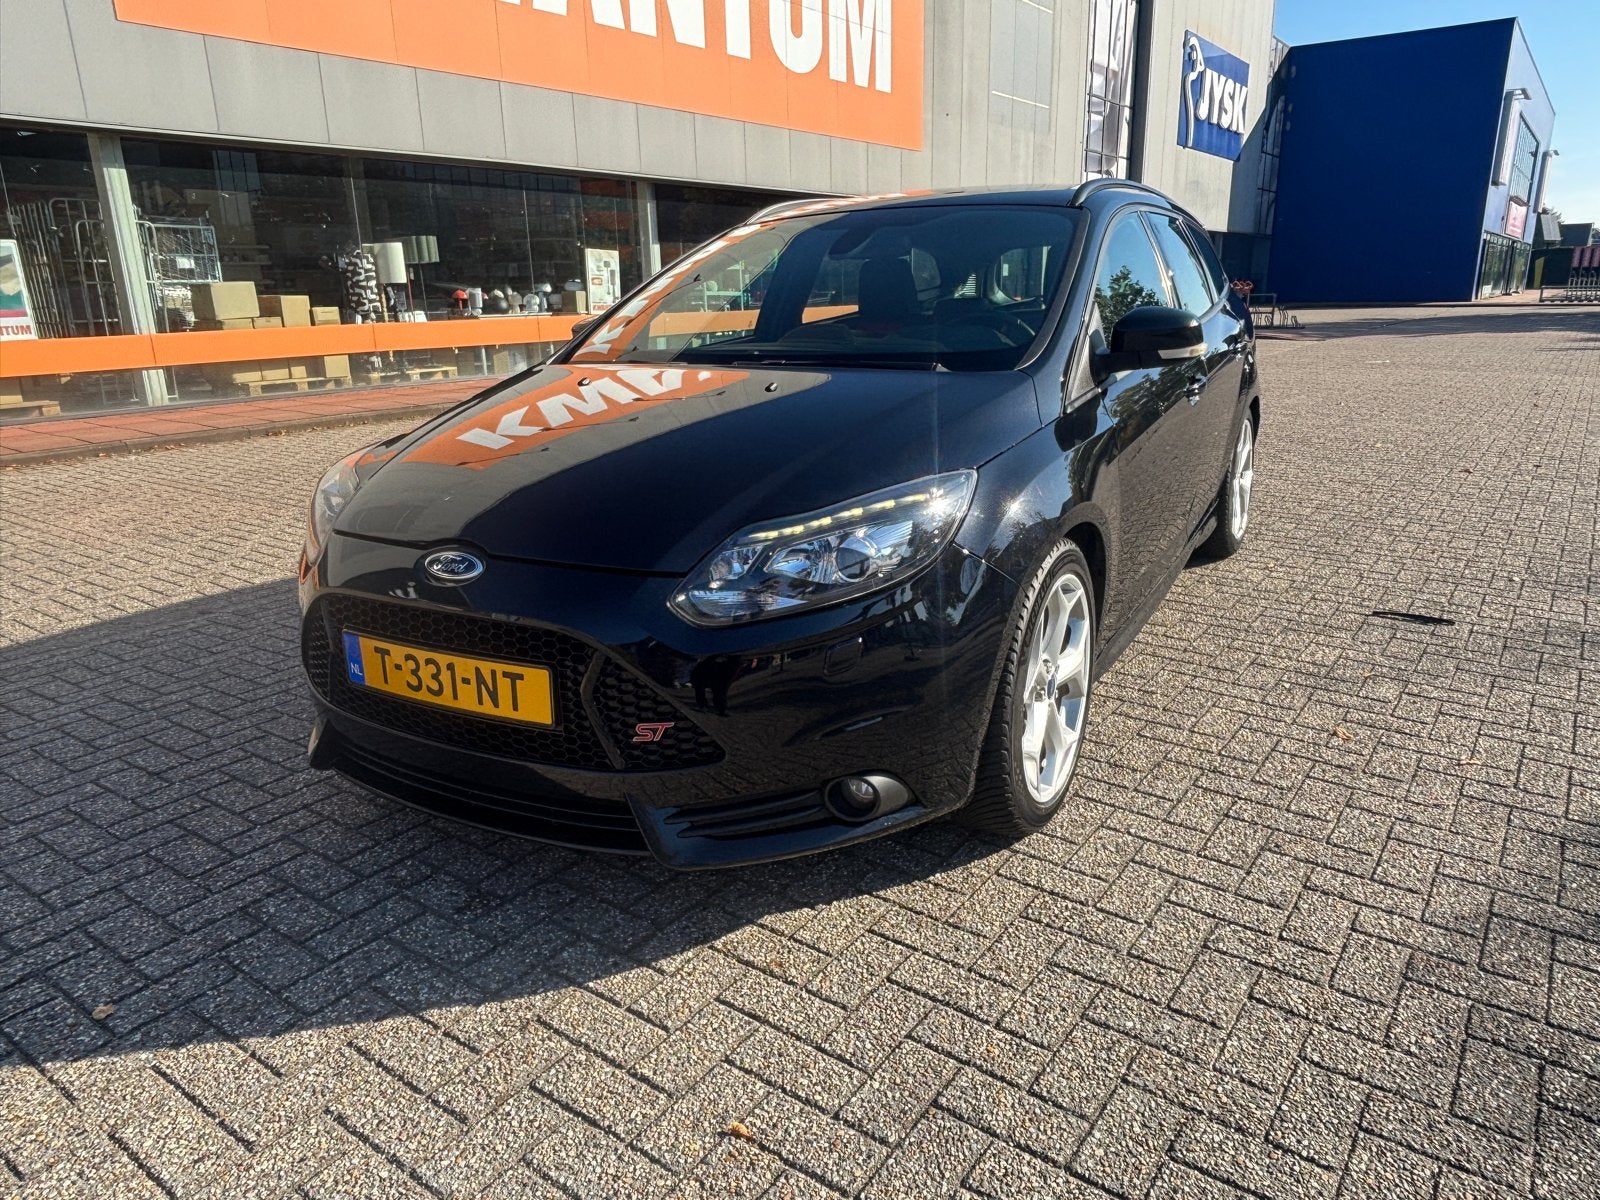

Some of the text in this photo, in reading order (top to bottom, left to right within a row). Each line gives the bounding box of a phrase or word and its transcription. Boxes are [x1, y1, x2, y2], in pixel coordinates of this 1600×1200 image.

[1196, 67, 1248, 134] JYSK
[433, 554, 469, 573] Ford
[350, 662, 364, 676] NL
[374, 646, 525, 712] T-331-NT
[632, 722, 675, 742] ST
